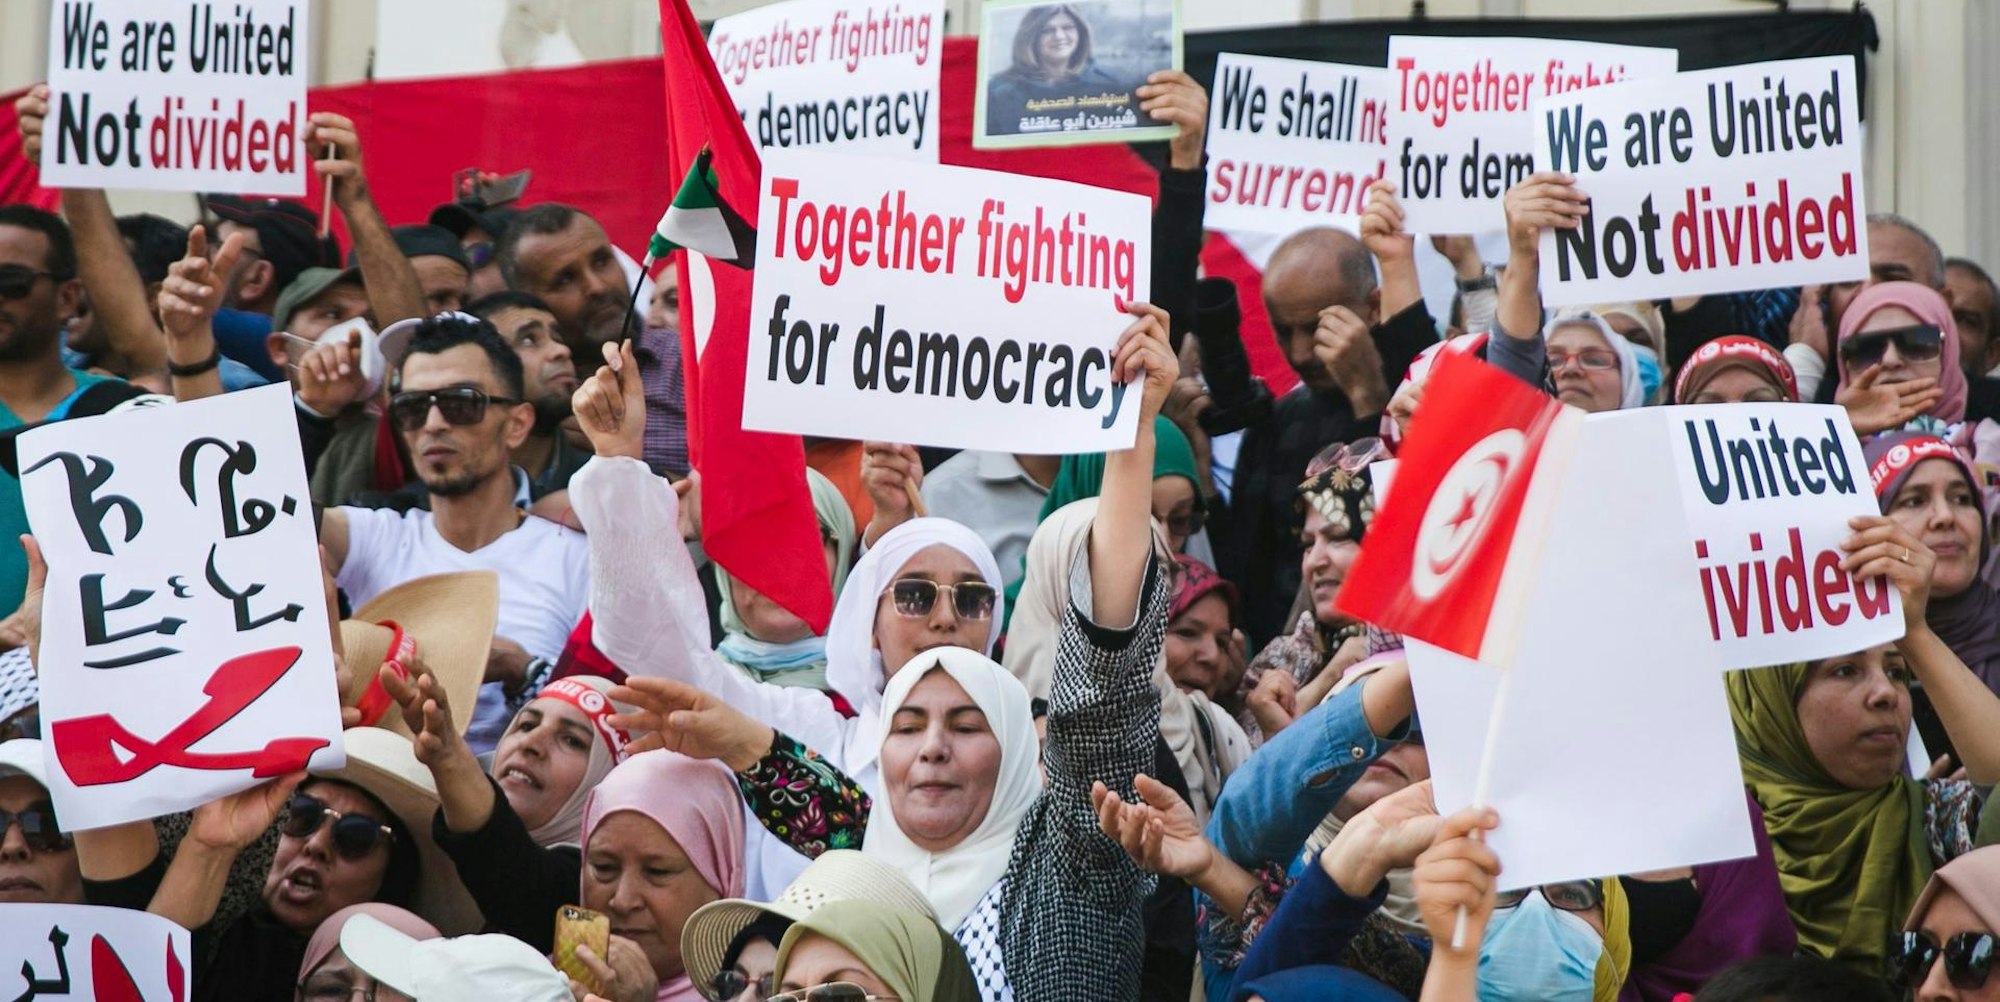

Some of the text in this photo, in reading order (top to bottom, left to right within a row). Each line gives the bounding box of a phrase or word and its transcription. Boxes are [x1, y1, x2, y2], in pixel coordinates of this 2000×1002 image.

[64, 2, 295, 76] We are United
[715, 4, 932, 86] Together fighting
[57, 92, 297, 174] Not divided
[758, 90, 930, 150] democracy
[1018, 107, 1138, 132] شيرين أبو عاقلة
[1220, 64, 1267, 134] We
[1277, 72, 1358, 142] shall
[1396, 56, 1535, 128] Together
[1546, 102, 1608, 174] We
[1624, 106, 1693, 168] are
[1708, 69, 1844, 158] United
[1400, 137, 1448, 199] for
[770, 177, 1134, 313] Together fighting
[1554, 172, 1857, 282] Not divided
[768, 293, 1128, 430] for democracy
[1684, 416, 1858, 506] United
[179, 436, 304, 633] لرفع
[51, 645, 331, 788] لا
